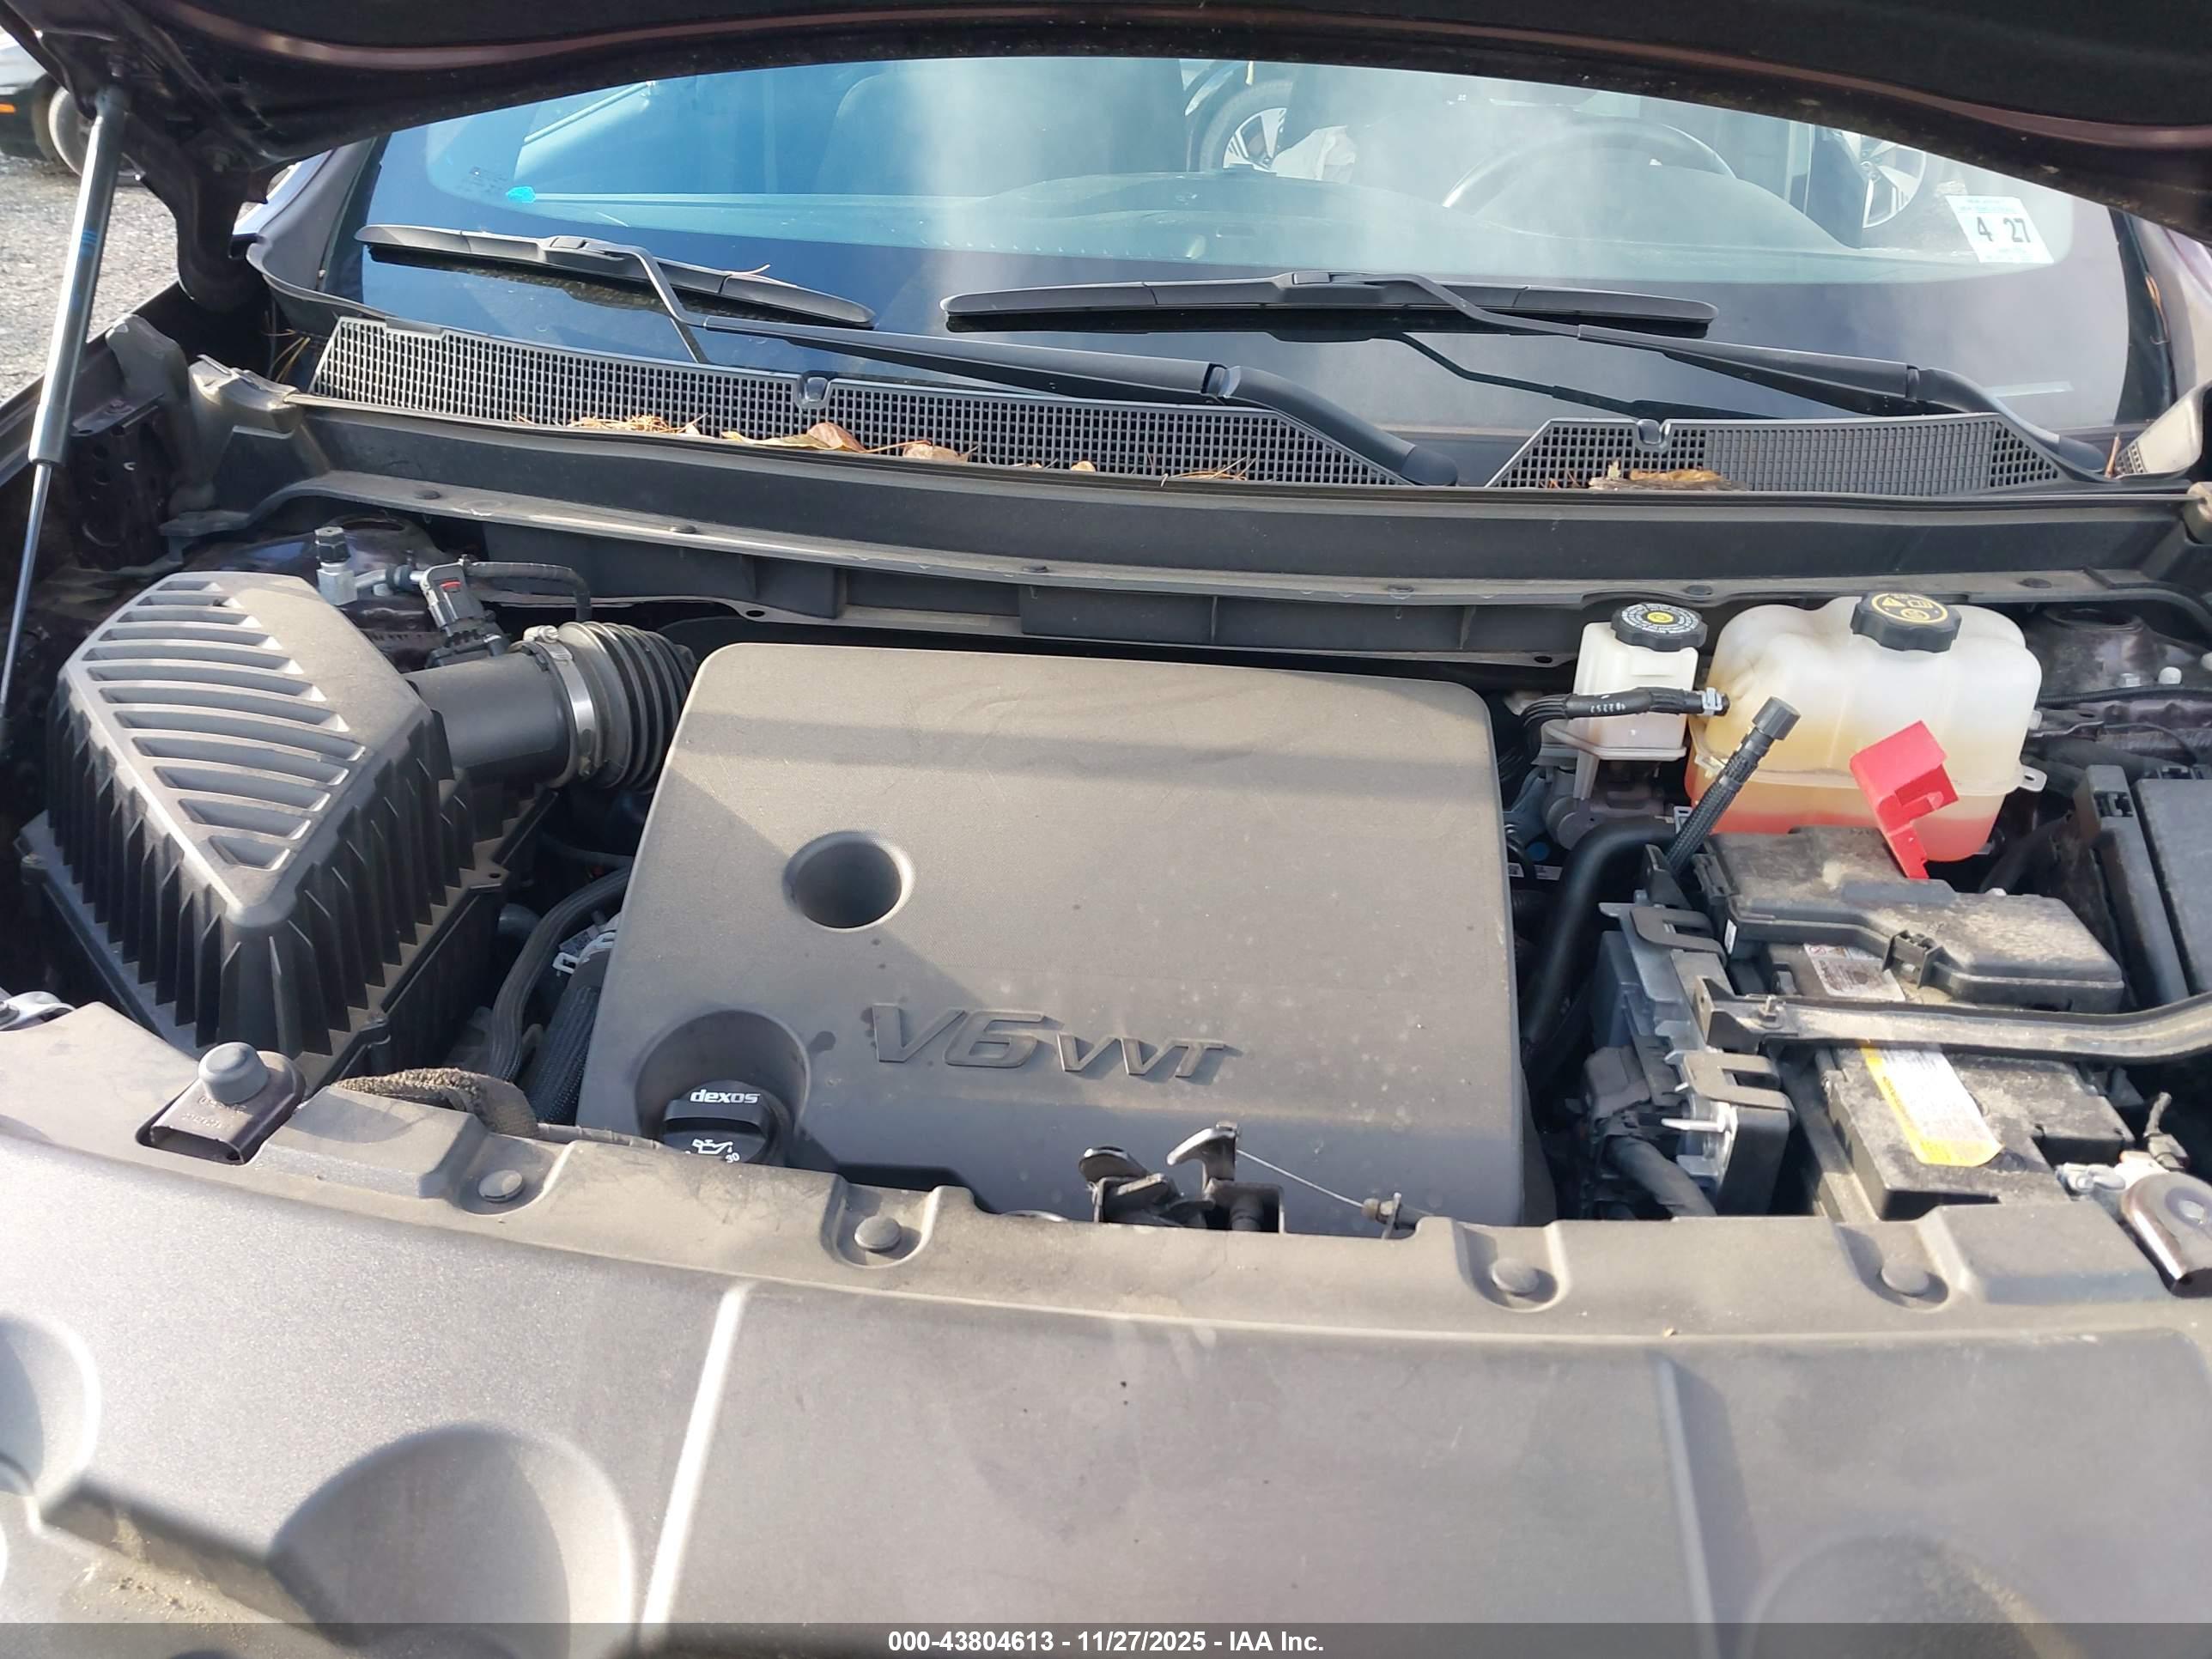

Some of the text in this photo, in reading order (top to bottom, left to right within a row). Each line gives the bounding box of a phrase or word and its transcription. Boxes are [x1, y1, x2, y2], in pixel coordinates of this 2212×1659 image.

[1977, 216, 2031, 243] 4 27
[872, 1002, 1225, 1079] V6 VVT
[690, 1089, 761, 1104] dexos
